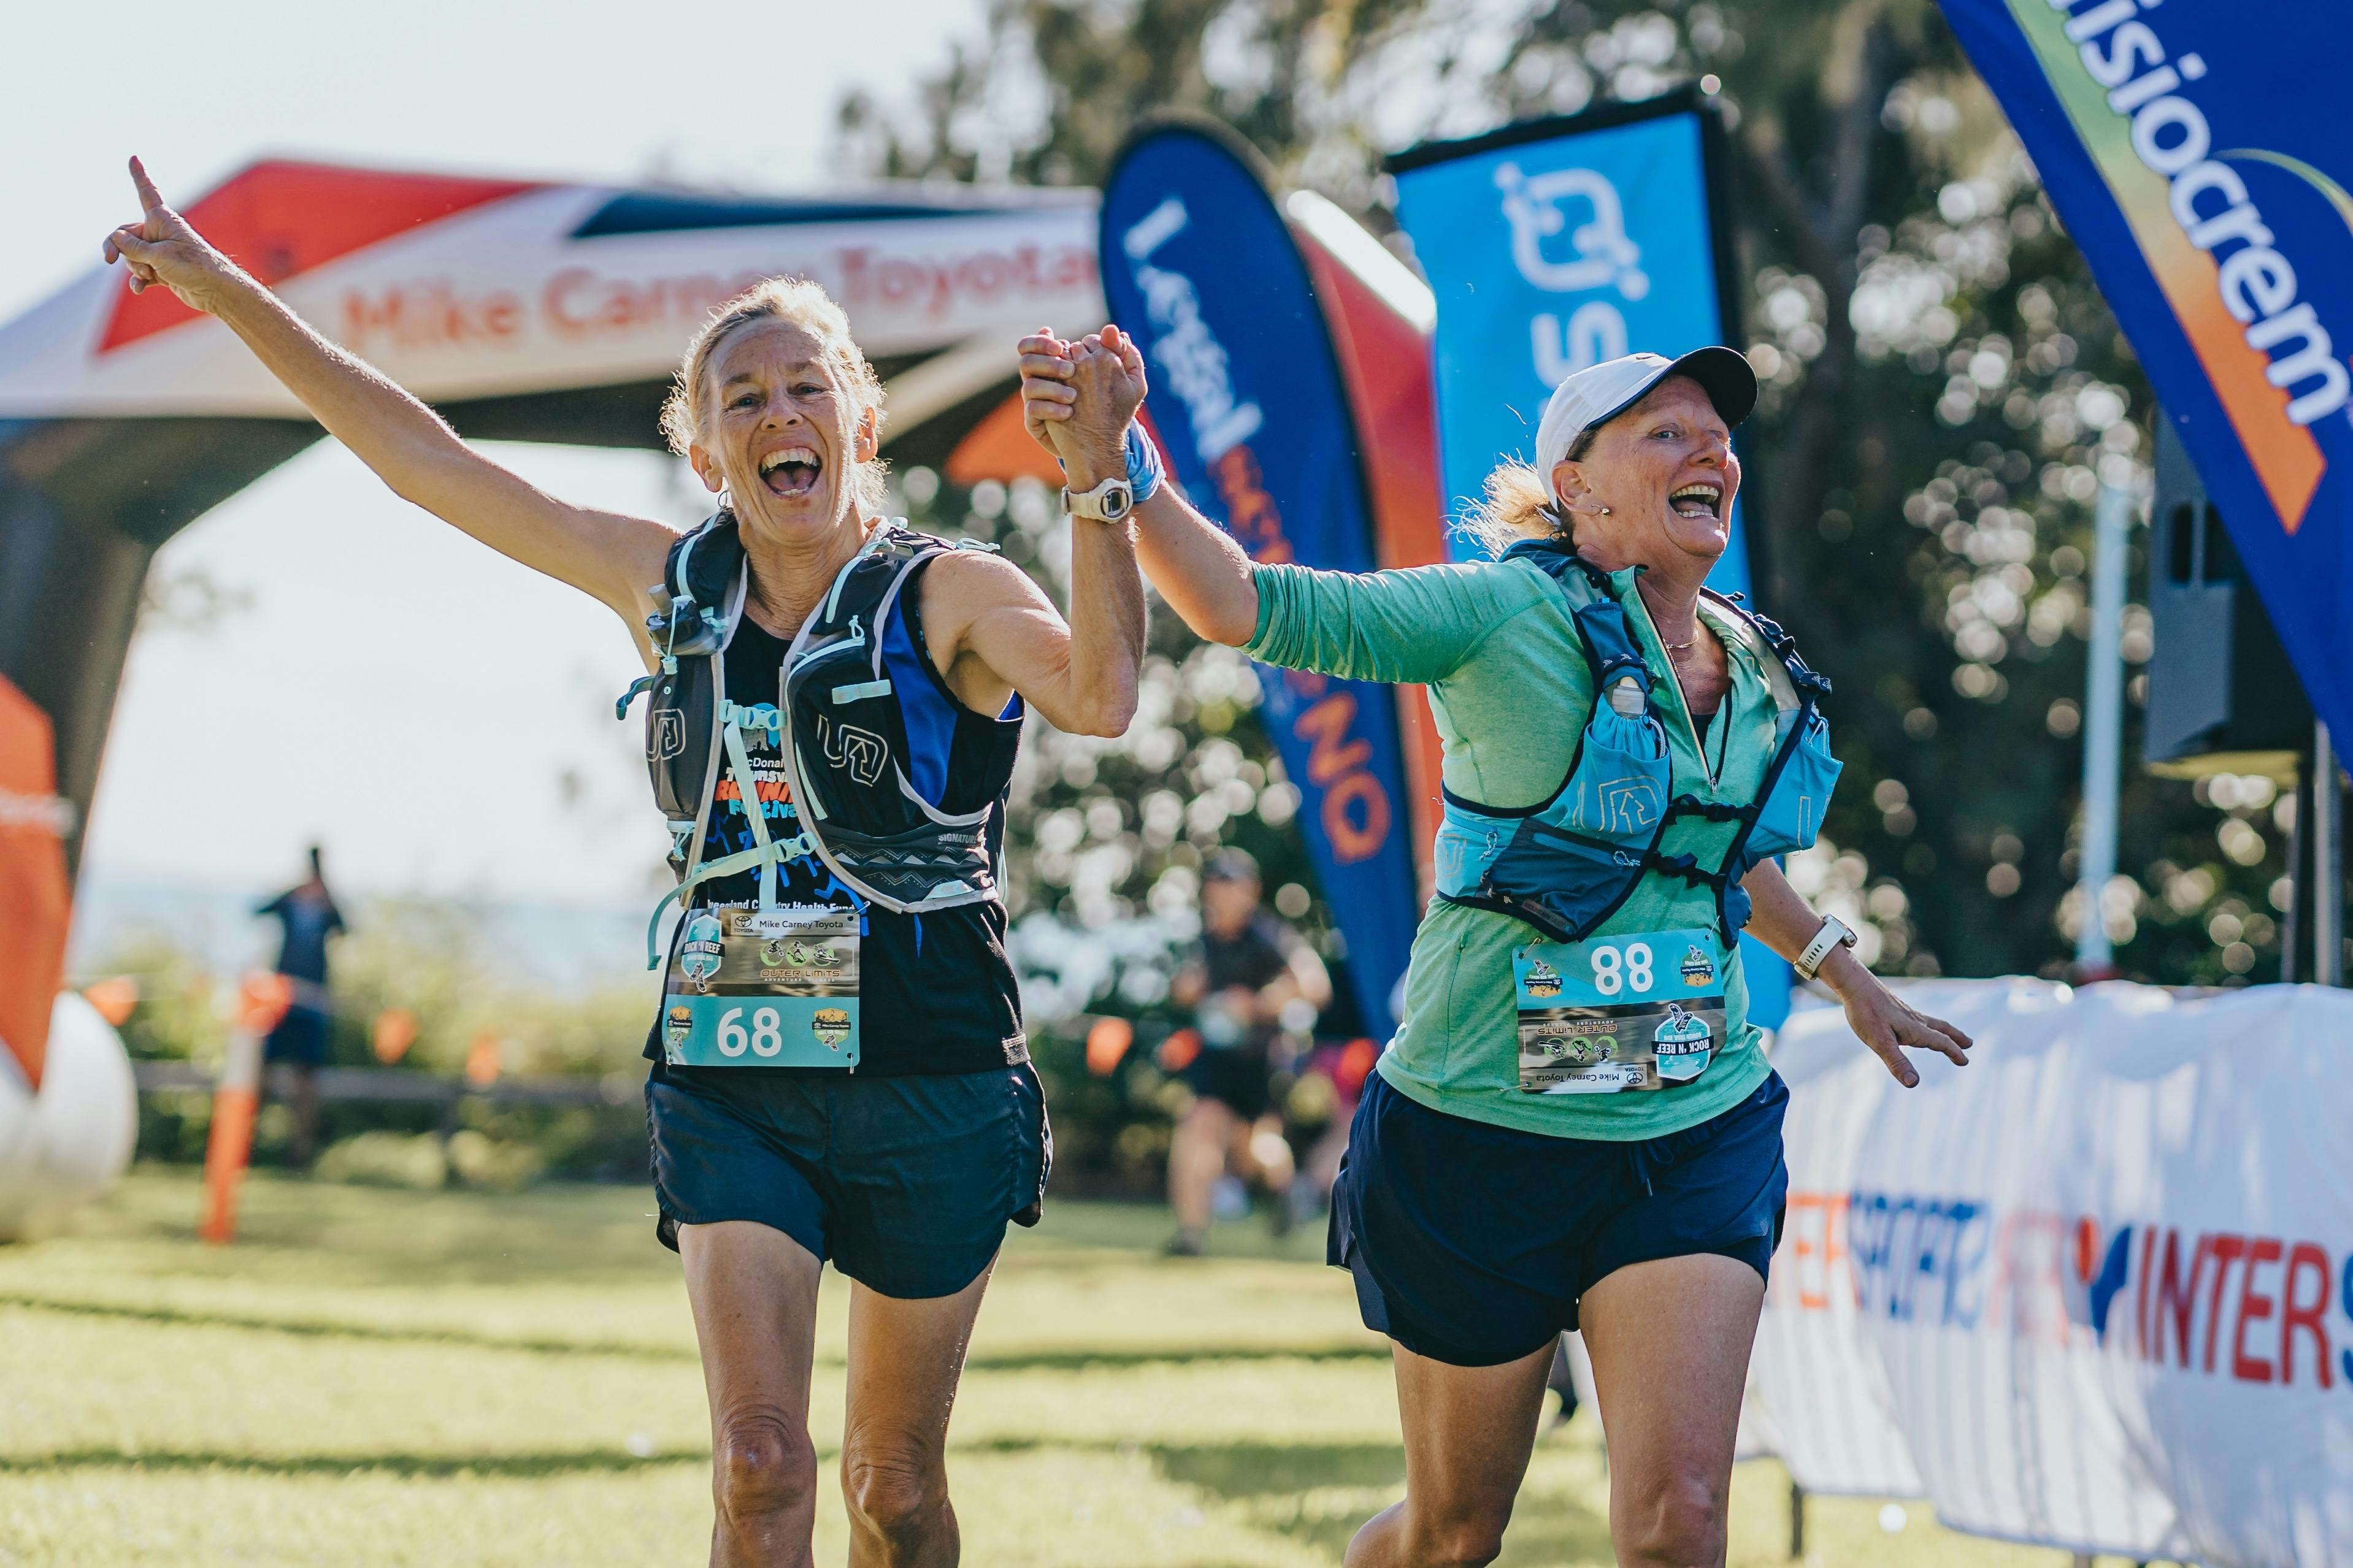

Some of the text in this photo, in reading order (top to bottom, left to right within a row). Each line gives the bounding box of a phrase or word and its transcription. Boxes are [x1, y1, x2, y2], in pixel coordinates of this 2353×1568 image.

[2047, 0, 2351, 426] isiocrem
[342, 243, 1102, 346] Mike Carne Toyota
[748, 757, 785, 768] cDonal
[782, 920, 812, 930] Carney
[815, 920, 843, 930] Toyota
[706, 941, 721, 954] REEF
[761, 969, 800, 977] OUTER
[1590, 942, 1654, 995] 88
[716, 1006, 783, 1058] 68
[1657, 1043, 1676, 1054] REEF
[1689, 1038, 1710, 1053] ROCK
[1536, 1073, 1564, 1082] Toyota
[1567, 1073, 1597, 1082] Carney
[2136, 1224, 2353, 1388] INTER
